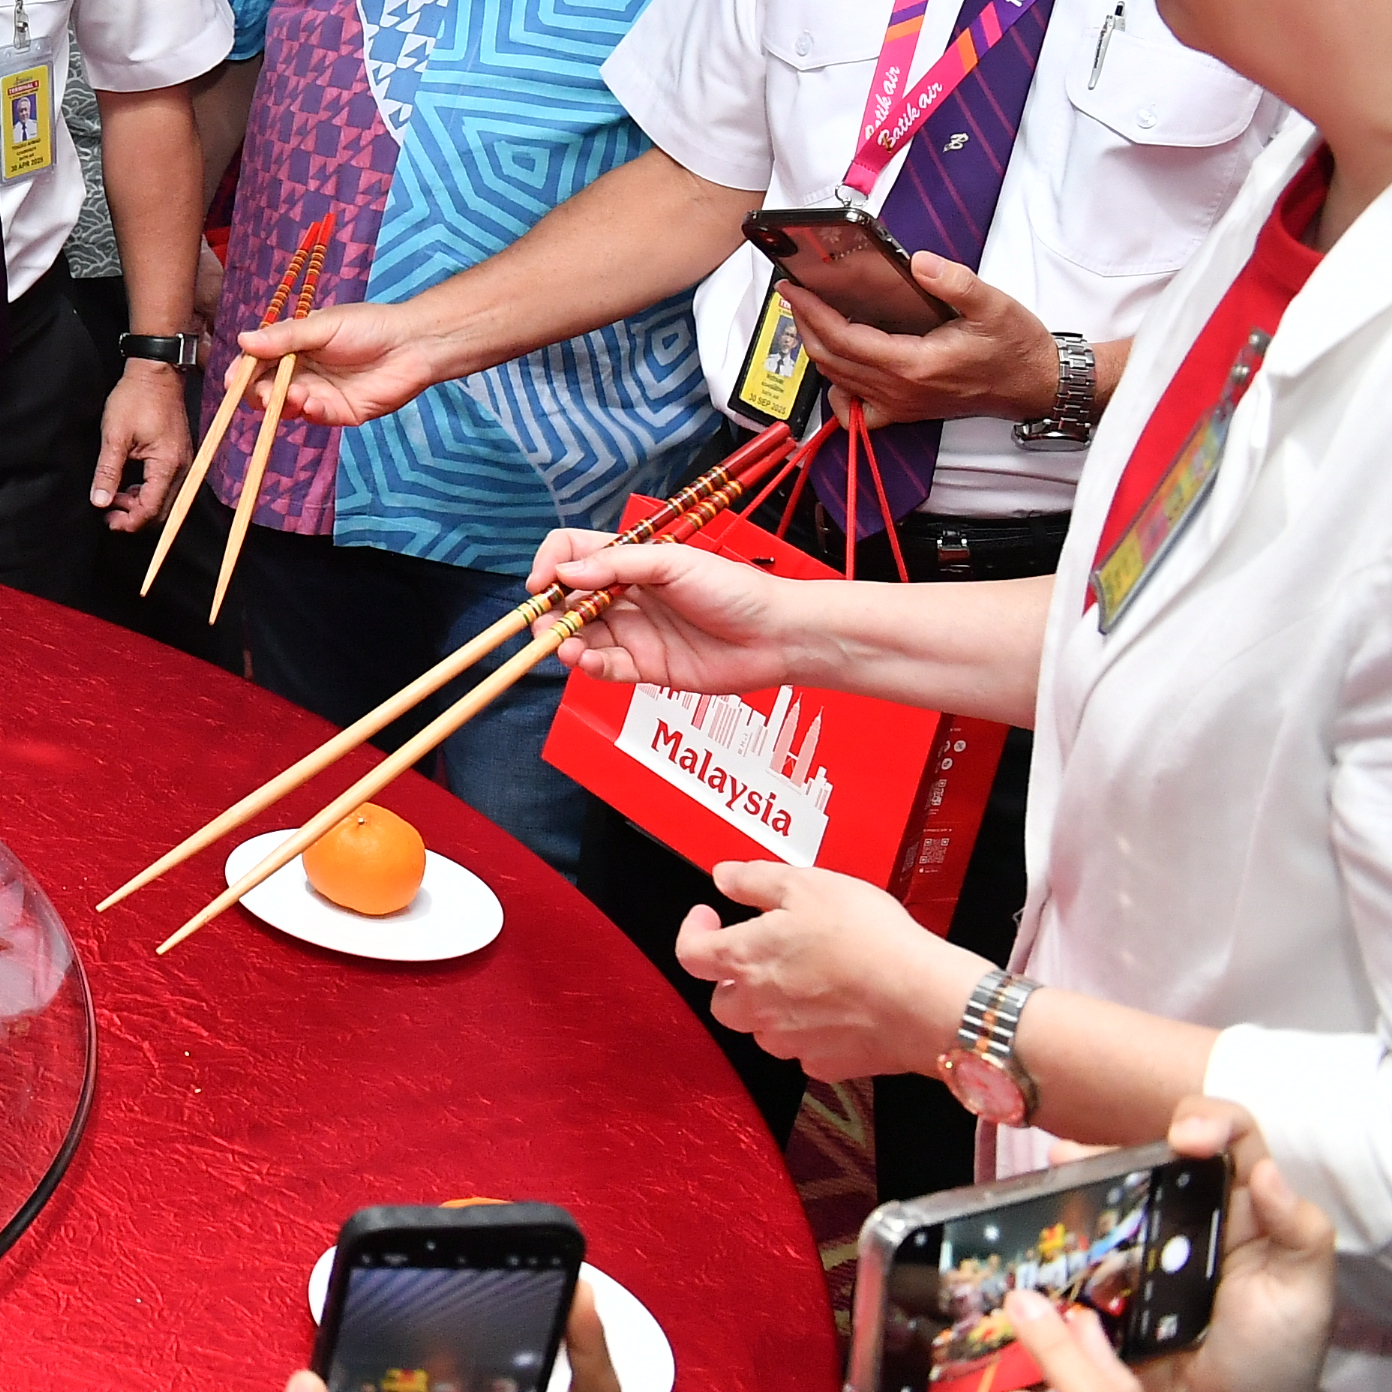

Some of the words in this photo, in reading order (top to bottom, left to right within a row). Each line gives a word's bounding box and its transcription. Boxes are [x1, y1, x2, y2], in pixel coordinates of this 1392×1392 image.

[883, 65, 901, 95] air
[877, 102, 921, 150] Batik
[918, 82, 943, 109] air
[756, 395, 771, 407] SEP
[650, 717, 793, 838] Malaysia
